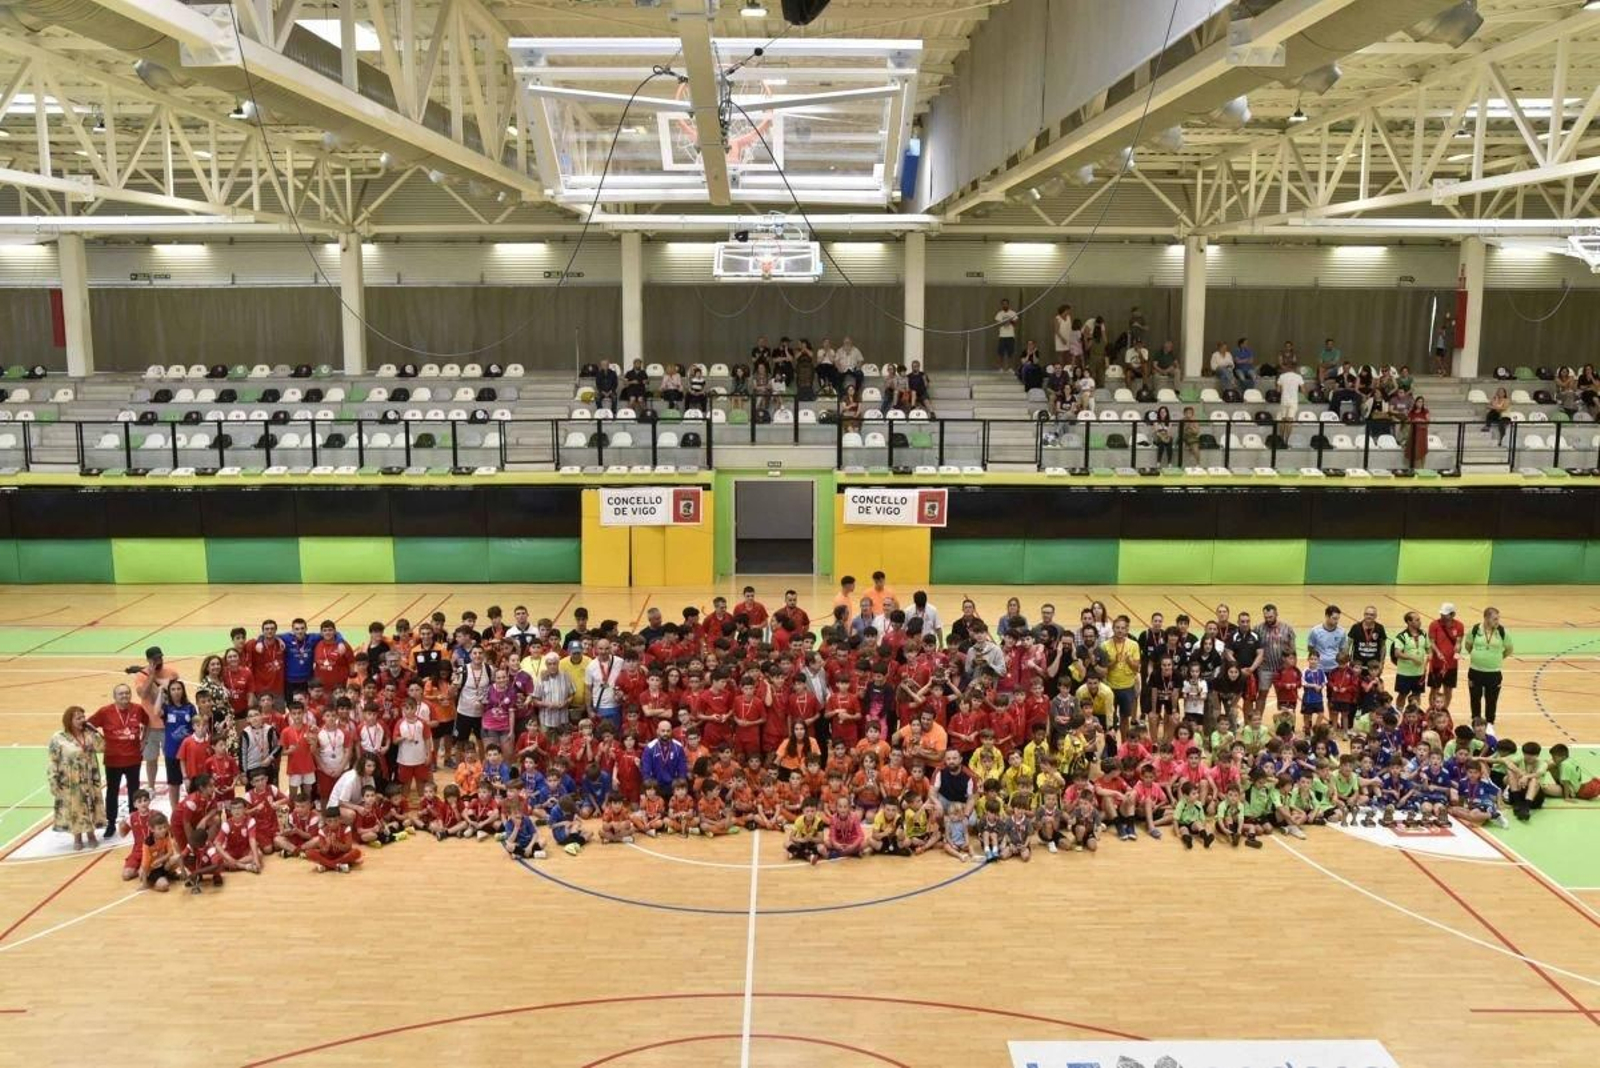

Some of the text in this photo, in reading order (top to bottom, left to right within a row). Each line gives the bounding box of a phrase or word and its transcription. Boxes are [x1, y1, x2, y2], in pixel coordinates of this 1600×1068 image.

[607, 496, 662, 505] CONCELLO
[851, 495, 907, 505] CONCELLO
[614, 506, 656, 515] DE VIGO
[858, 505, 901, 515] DE VIGO
